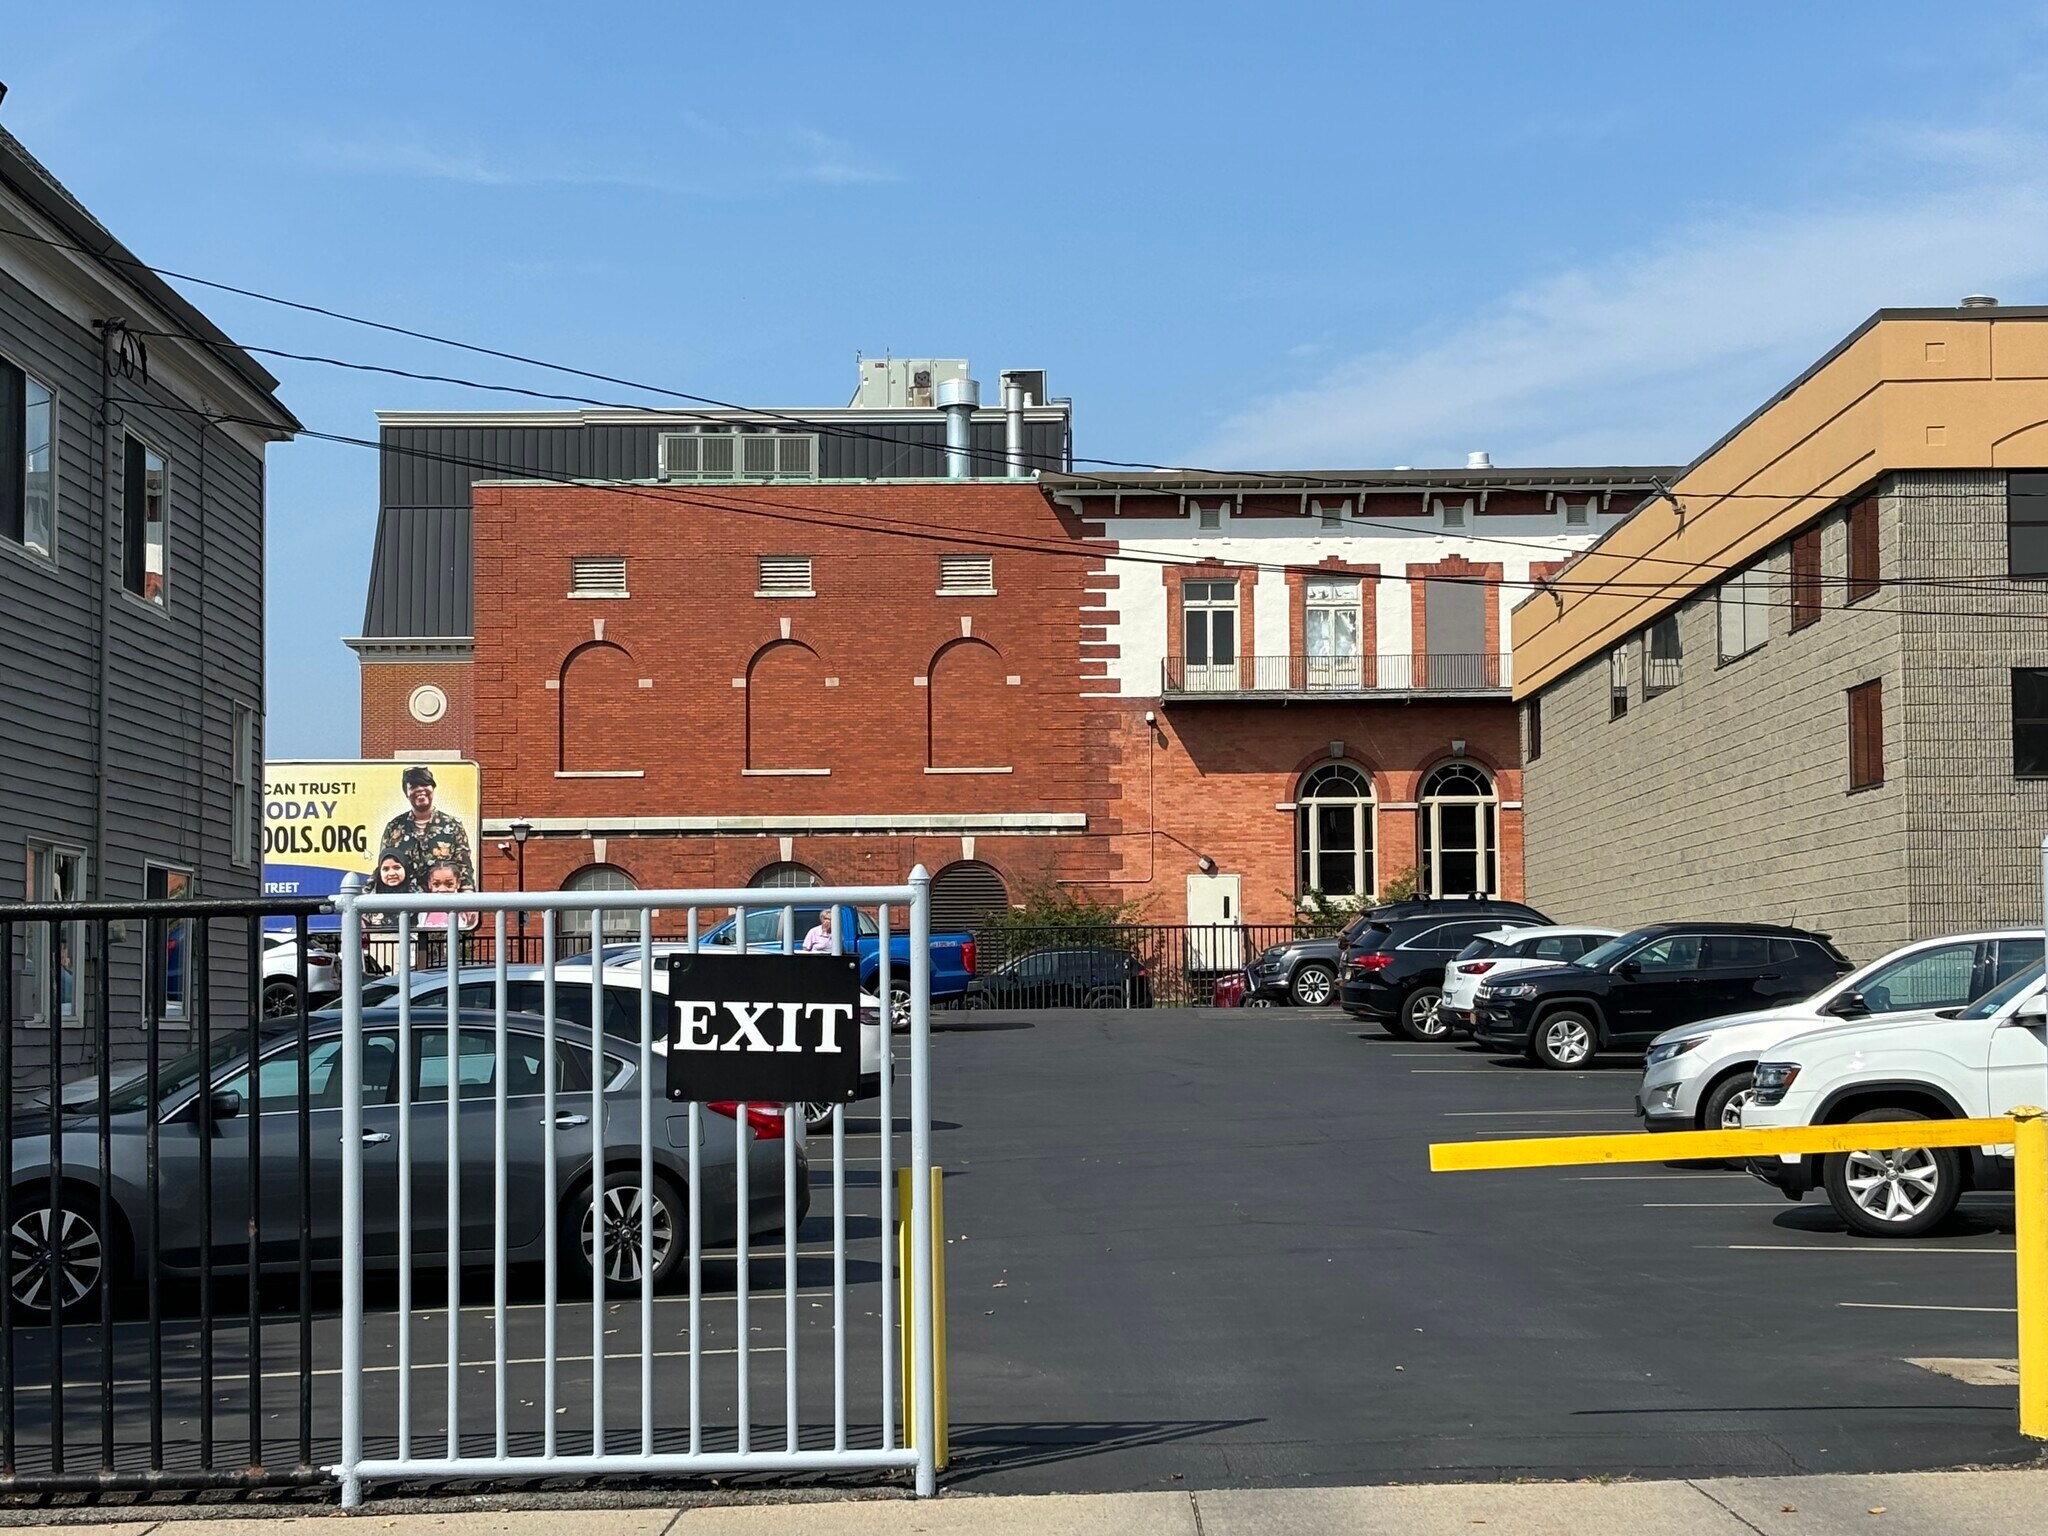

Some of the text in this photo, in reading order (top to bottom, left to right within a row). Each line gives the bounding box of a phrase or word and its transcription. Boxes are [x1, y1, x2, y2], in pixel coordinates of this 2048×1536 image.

[264, 782, 356, 796] CAN TRUST!
[266, 801, 338, 820] ODAY
[673, 1000, 853, 1053] EXIT
